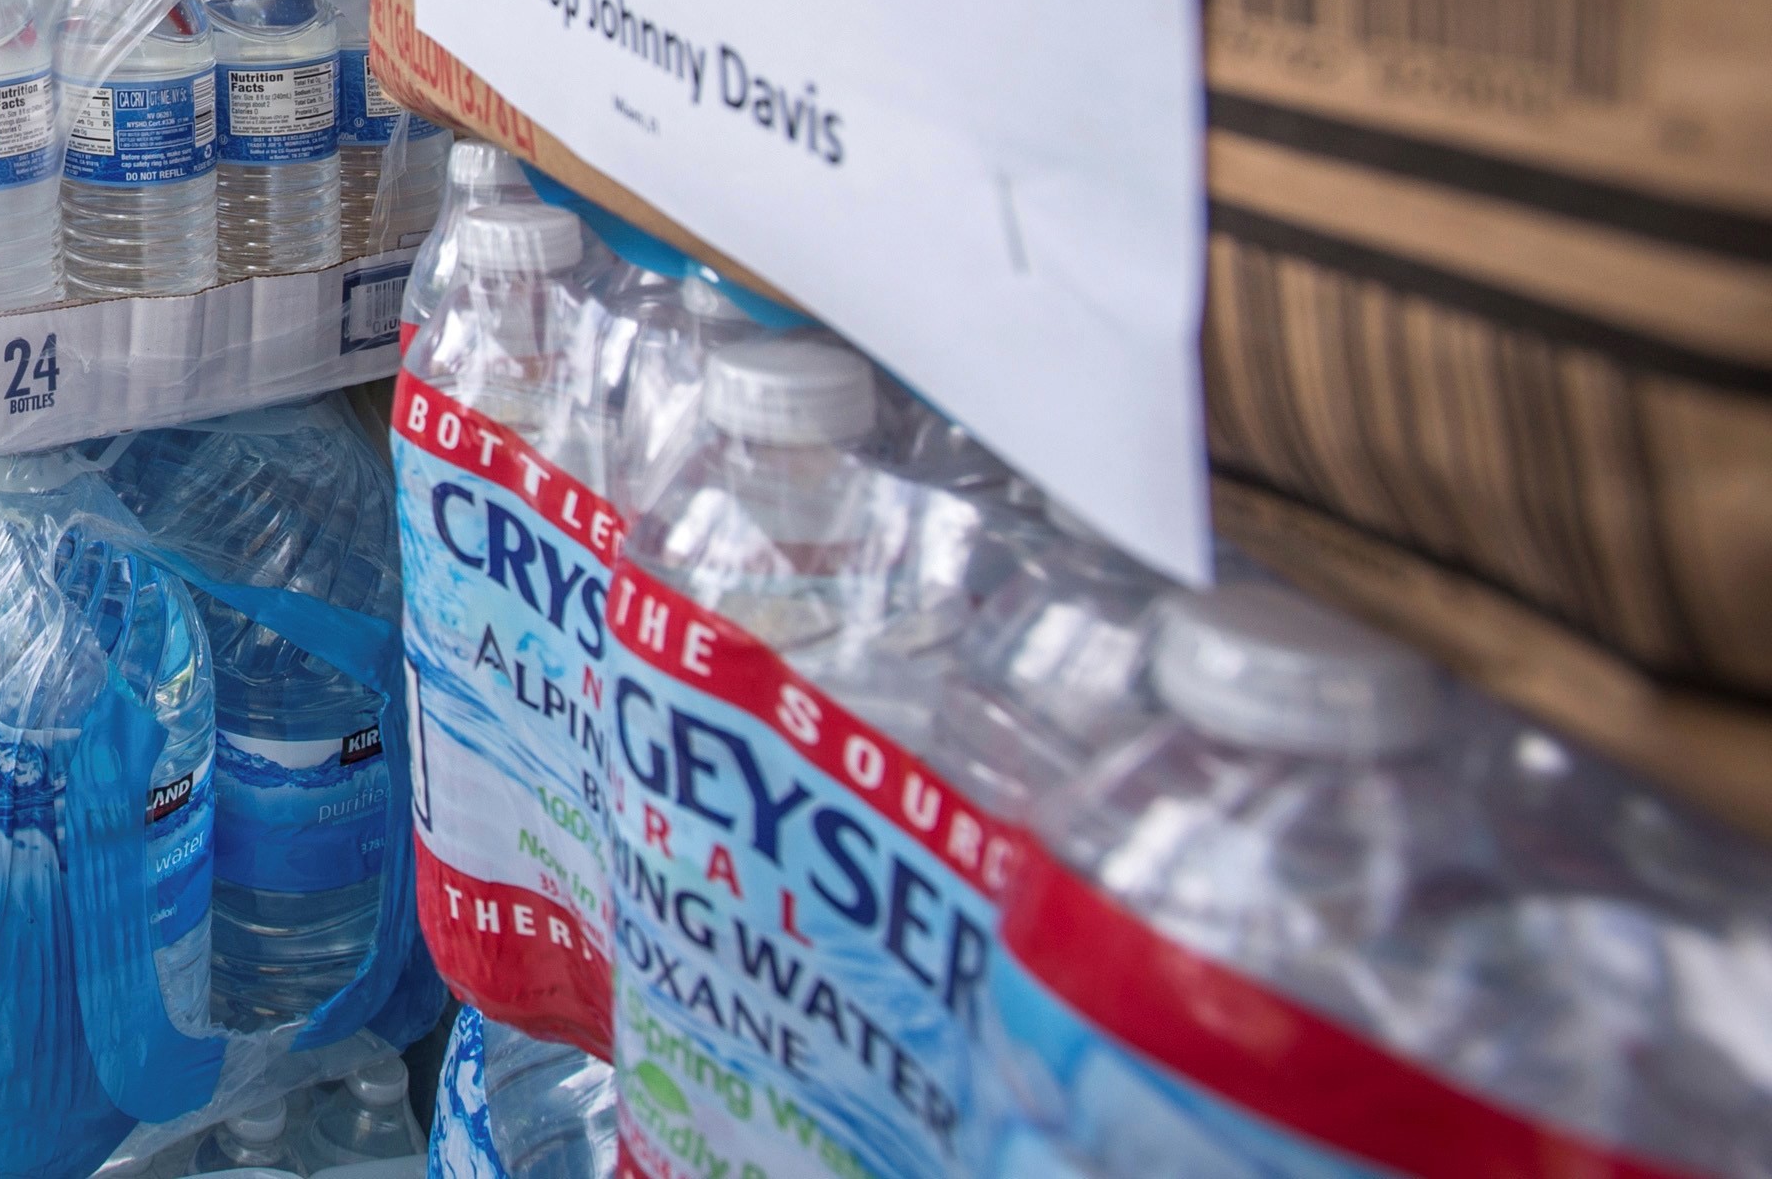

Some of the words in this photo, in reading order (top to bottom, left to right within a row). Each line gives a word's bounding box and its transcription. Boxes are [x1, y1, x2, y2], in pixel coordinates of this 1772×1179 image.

[230, 72, 284, 83] Nutrition
[231, 82, 265, 93] Facts
[119, 92, 130, 108] CA
[130, 91, 145, 108] CRV
[719, 41, 848, 168] Davis
[121, 153, 141, 161] Before
[121, 162, 132, 170] cap
[133, 160, 151, 169] safety
[150, 159, 162, 168] ring
[125, 172, 138, 182] DO
[139, 171, 157, 181] NOT
[159, 168, 188, 180] REFILL.
[2, 332, 60, 401] 24
[9, 391, 56, 416] BOTTLES
[614, 576, 718, 677] THE
[155, 830, 206, 874] water
[615, 673, 992, 1035] GEYSER
[731, 916, 961, 1158] WATER
